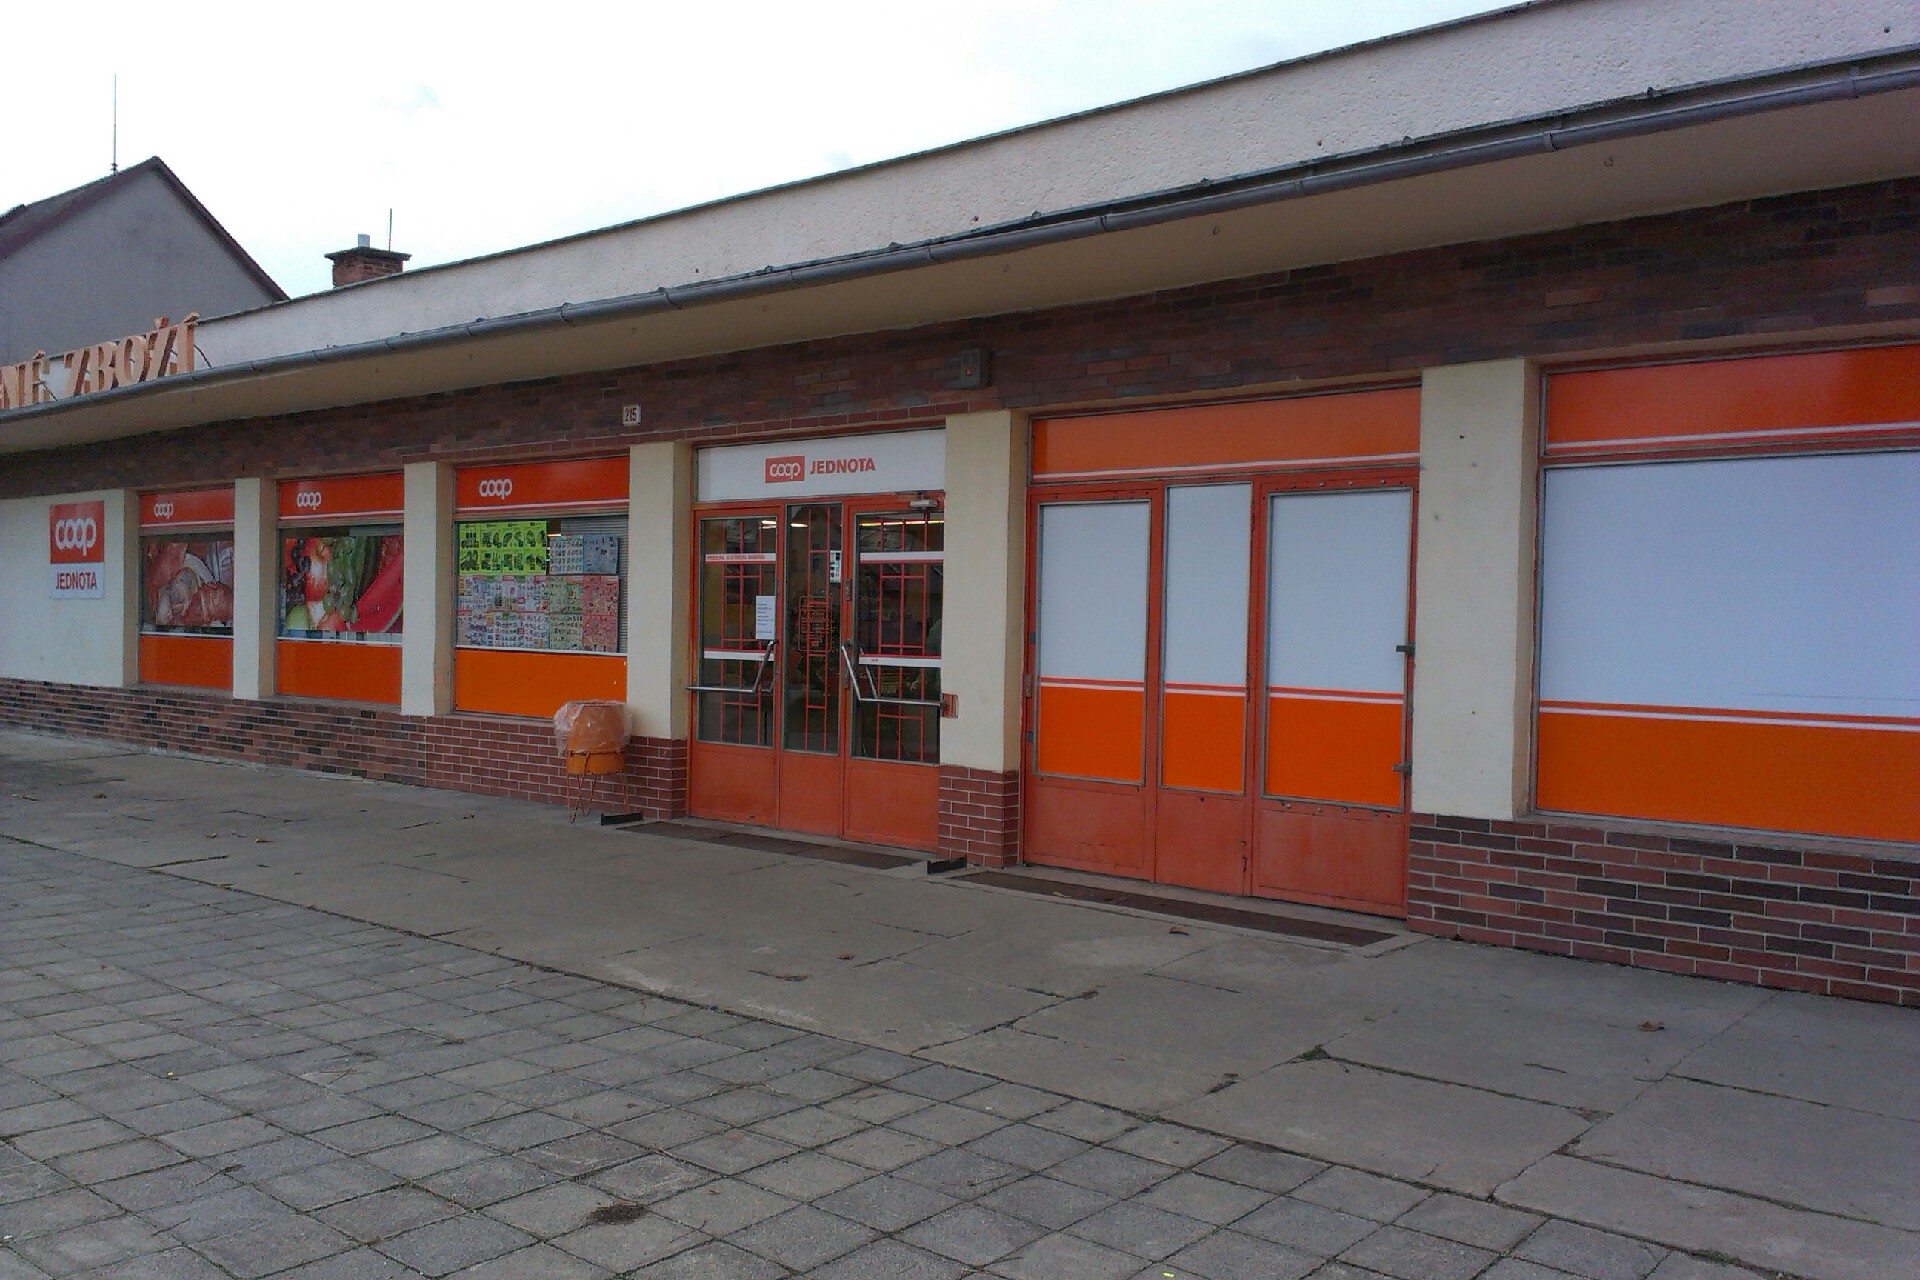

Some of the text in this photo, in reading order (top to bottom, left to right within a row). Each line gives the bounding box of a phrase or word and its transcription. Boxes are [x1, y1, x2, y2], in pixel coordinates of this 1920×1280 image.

[63, 311, 200, 396] ZBOŽÍ
[769, 457, 876, 479] coop JEDNOTA
[479, 478, 513, 500] coop
[153, 501, 174, 519] coop
[296, 491, 322, 510] coop
[54, 516, 97, 556] coop
[55, 571, 97, 590] JEDNOTA
